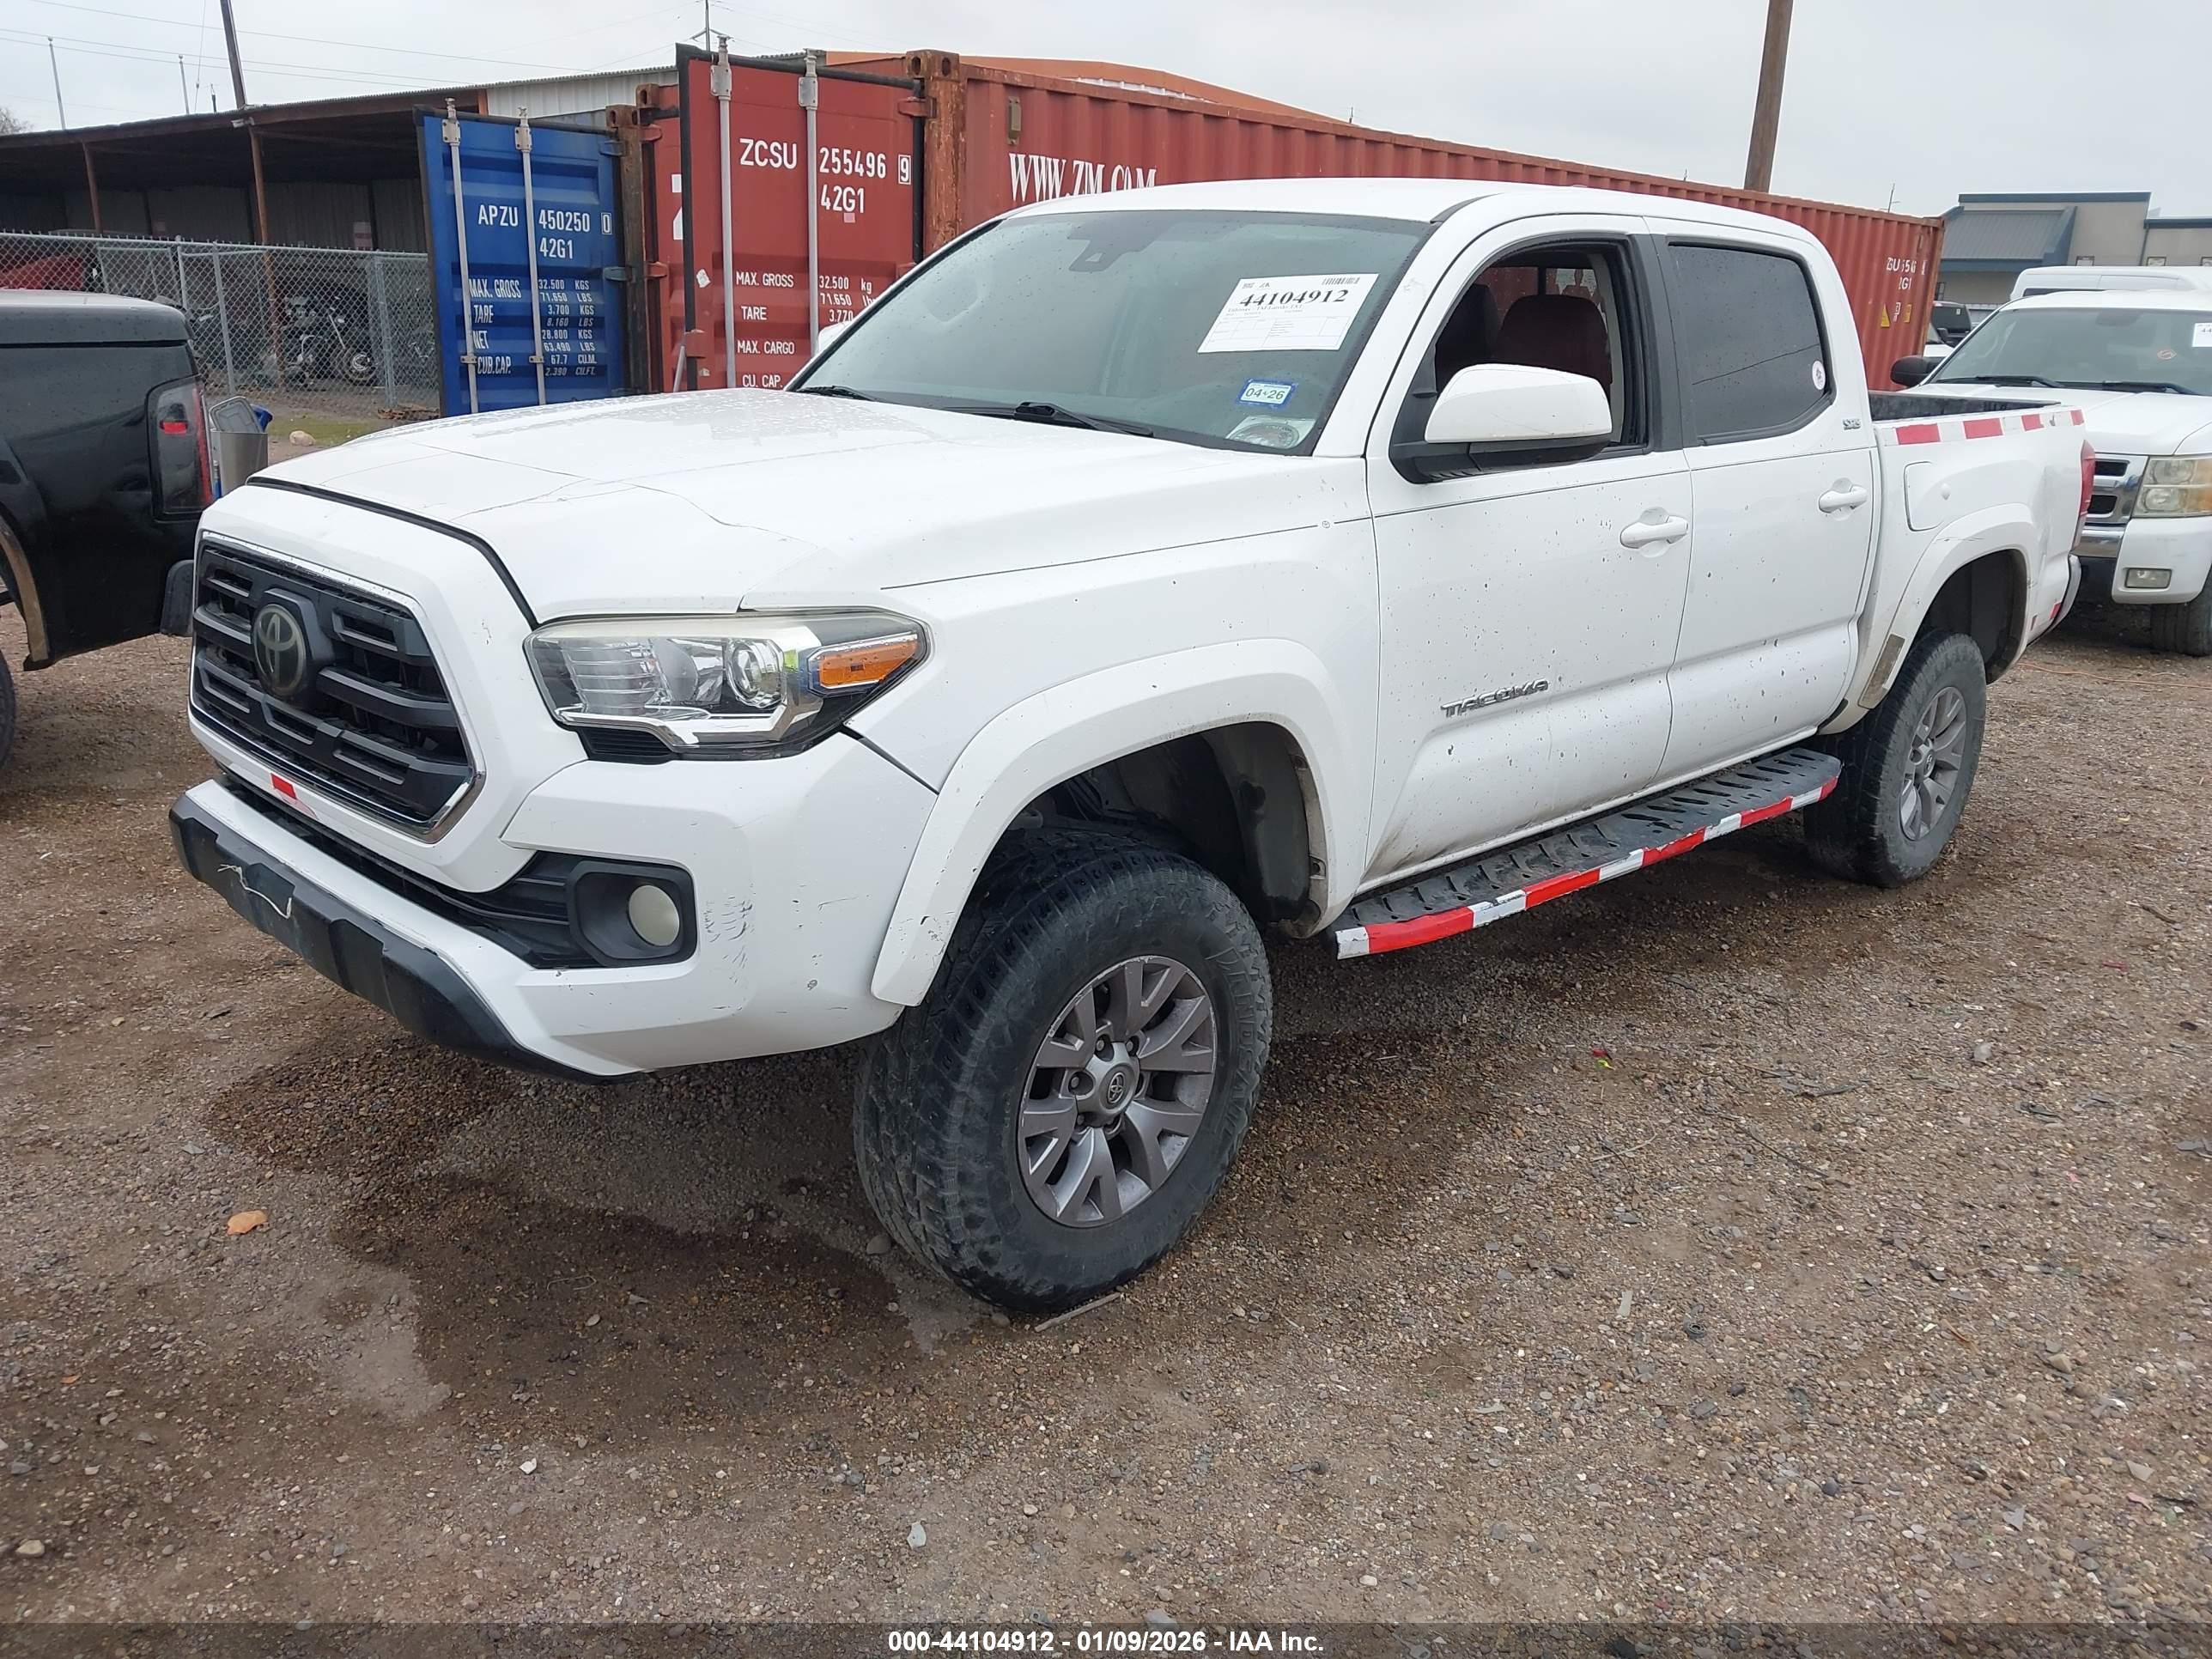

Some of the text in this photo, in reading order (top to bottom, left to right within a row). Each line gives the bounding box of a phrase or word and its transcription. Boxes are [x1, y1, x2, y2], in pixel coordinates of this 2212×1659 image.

[739, 137, 910, 183] ZCSU 255496 9
[820, 184, 865, 213] 42G1
[477, 204, 611, 234] APZU 450250 0
[539, 237, 574, 259] 42G1
[469, 278, 590, 299] MAX. GROSS 32.500 KGS
[736, 271, 872, 295] MAX. GROSS 32.500 kg
[576, 293, 592, 302] LBS
[820, 293, 877, 307] 71.650 lb
[1239, 289, 1349, 307] 44104912
[473, 305, 595, 324] TARE 3.700 KGS
[741, 306, 768, 320] TARE
[578, 318, 593, 327] LBS
[472, 330, 489, 349] NET
[577, 329, 592, 339] KGS
[580, 342, 596, 352] LBS
[737, 340, 795, 355] MAX. CARGO
[550, 355, 568, 365] 67.7
[742, 374, 783, 388] CU. CAP.
